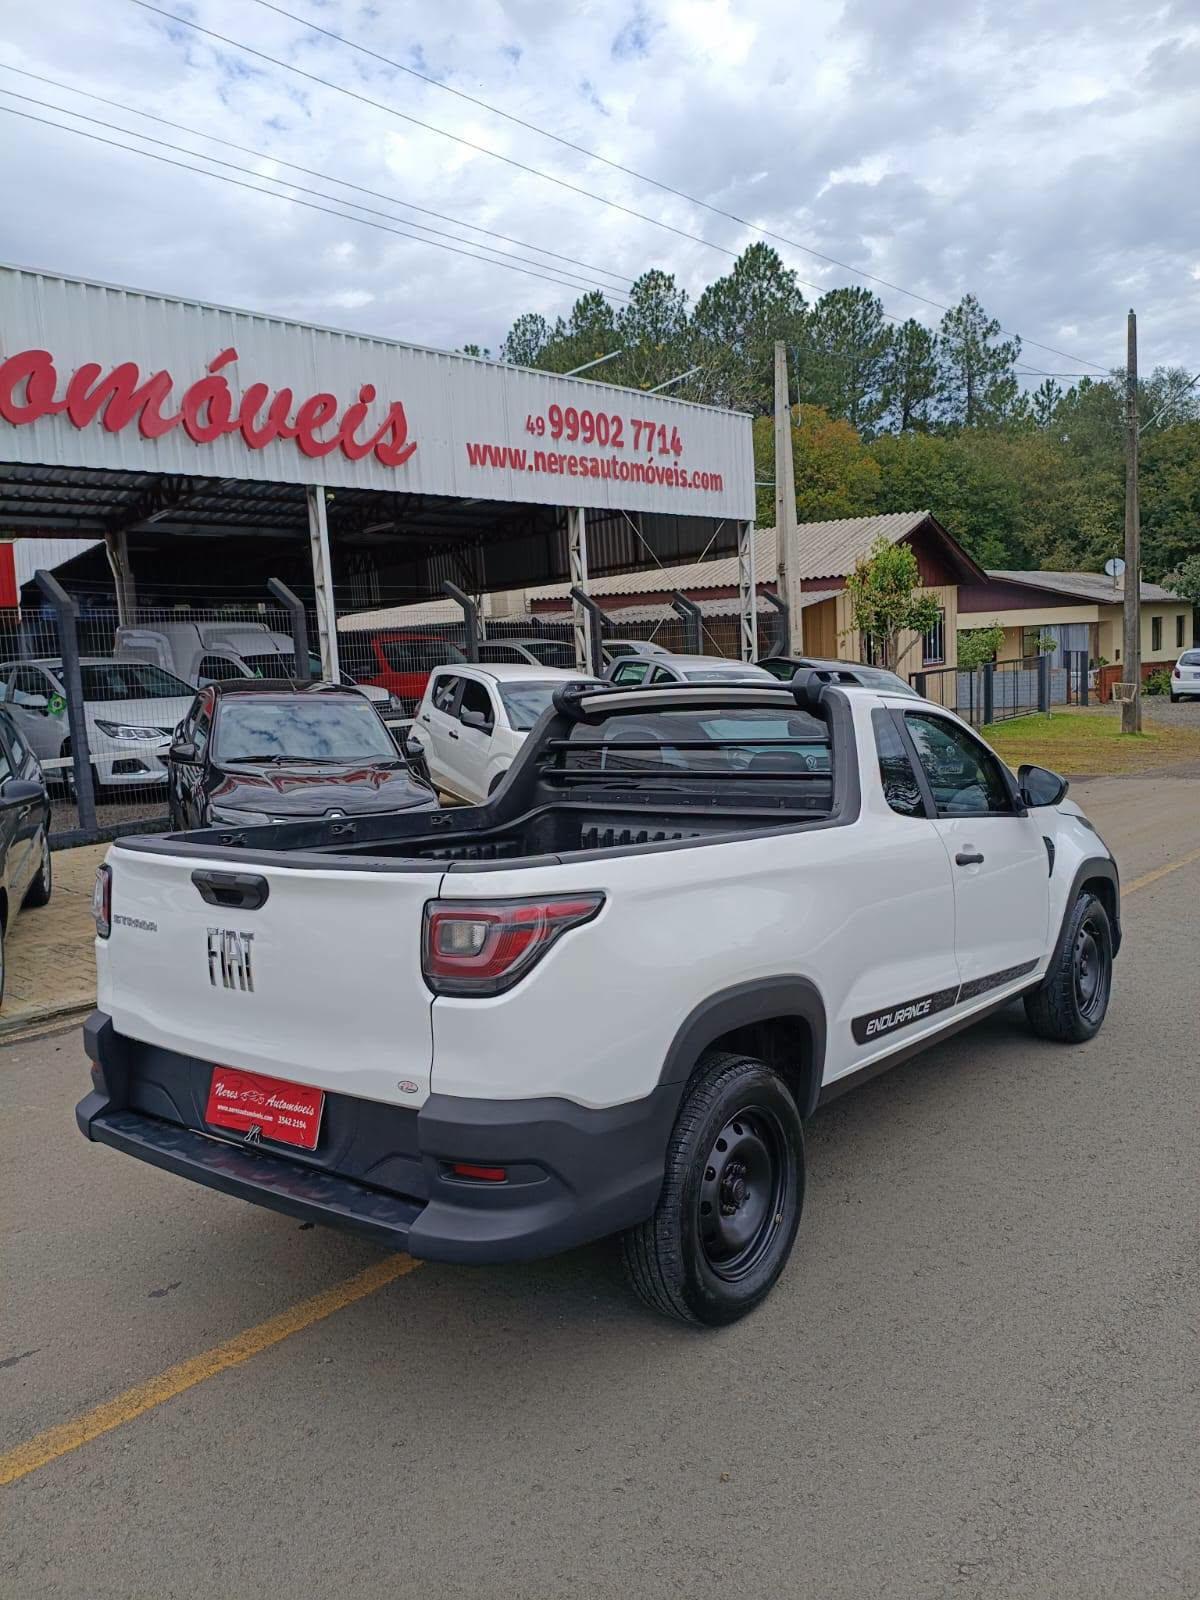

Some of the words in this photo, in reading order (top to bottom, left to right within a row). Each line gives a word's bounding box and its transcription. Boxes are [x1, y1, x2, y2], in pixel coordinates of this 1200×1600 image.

[525, 414, 545, 436] 49
[548, 404, 625, 448] 99902
[631, 418, 683, 456] 7714
[466, 442, 724, 491] www.neresautomóveis.com
[207, 927, 255, 992] FIAT
[866, 999, 932, 1036] ENDURANCE
[215, 1082, 238, 1100] Neres
